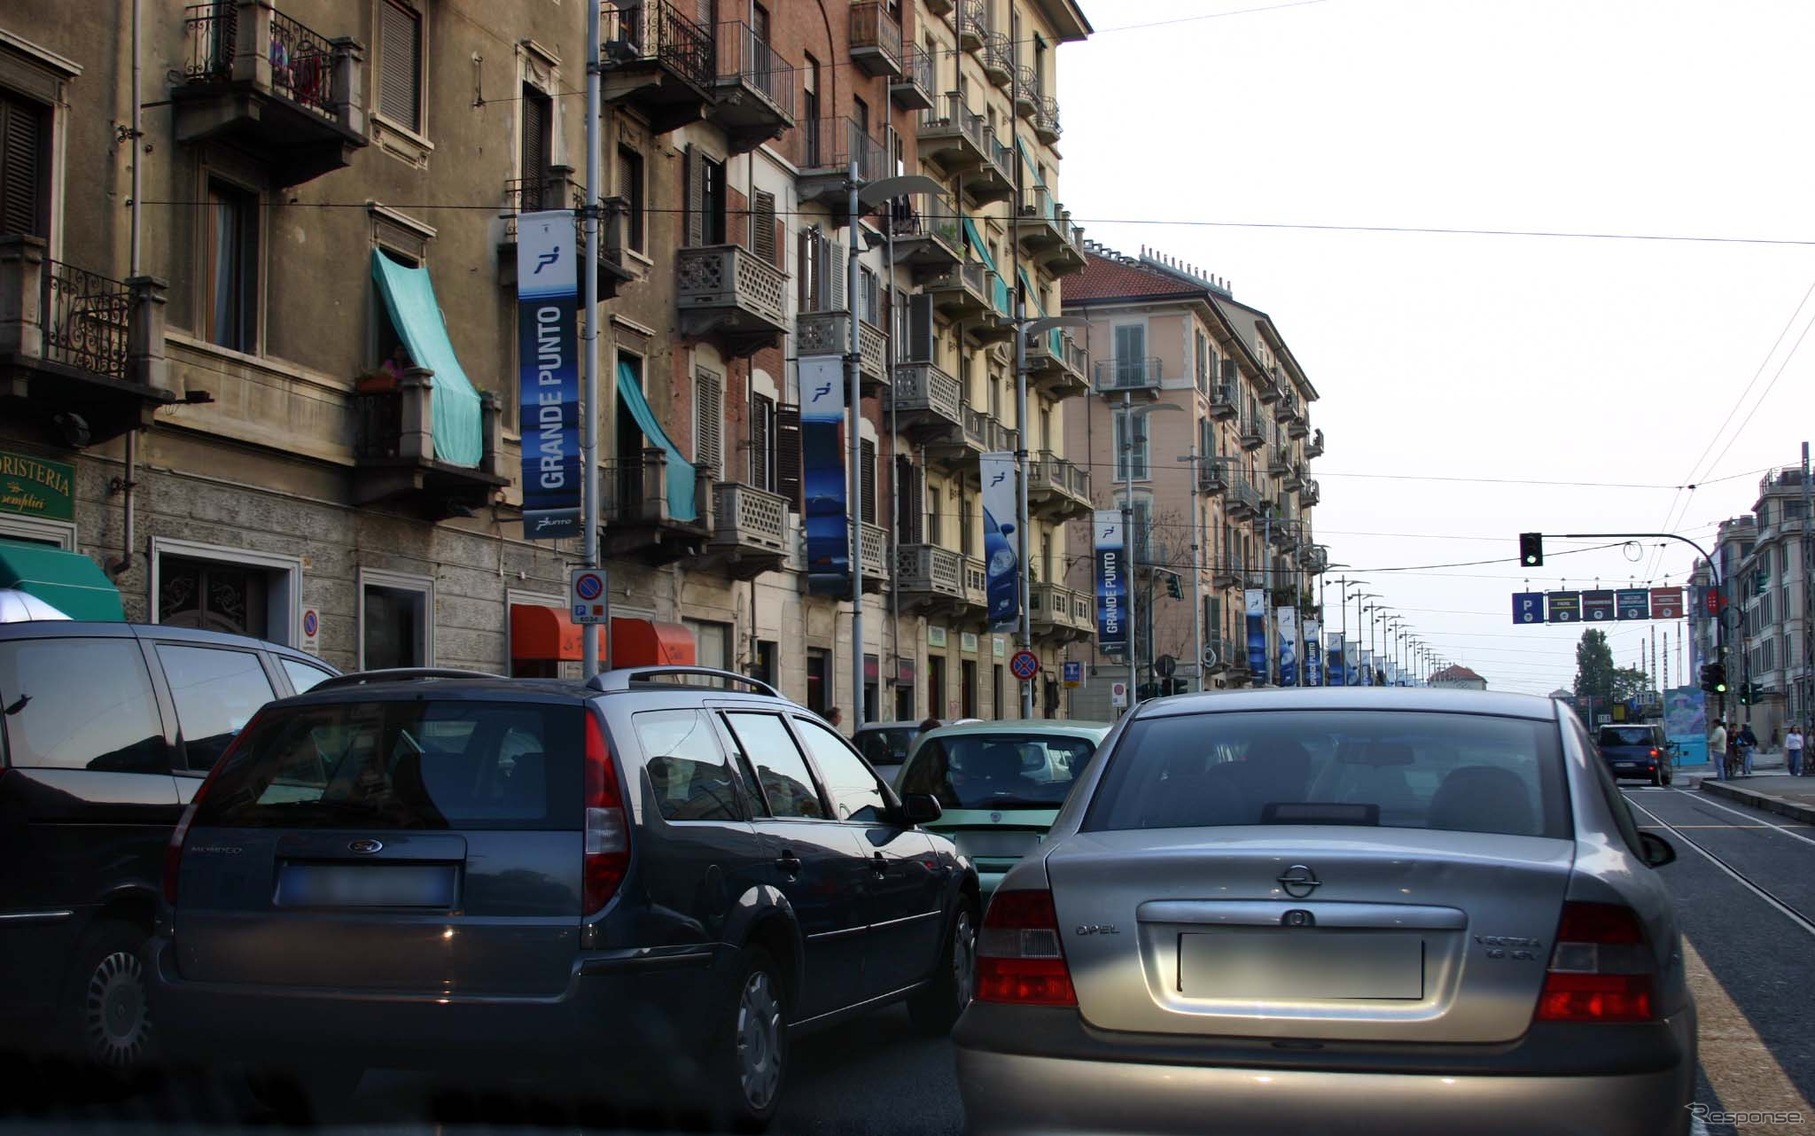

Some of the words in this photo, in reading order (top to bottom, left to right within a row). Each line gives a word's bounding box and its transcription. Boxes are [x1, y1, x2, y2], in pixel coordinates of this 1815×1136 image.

[537, 306, 561, 384] PUNTO
[539, 392, 565, 490] GRANDE
[0, 456, 69, 496] RISTERIA
[1104, 552, 1116, 589] PUNTO
[577, 606, 585, 614] P
[1105, 590, 1118, 634] GRANDE
[1523, 600, 1533, 611] P
[1076, 923, 1121, 936] OPEL
